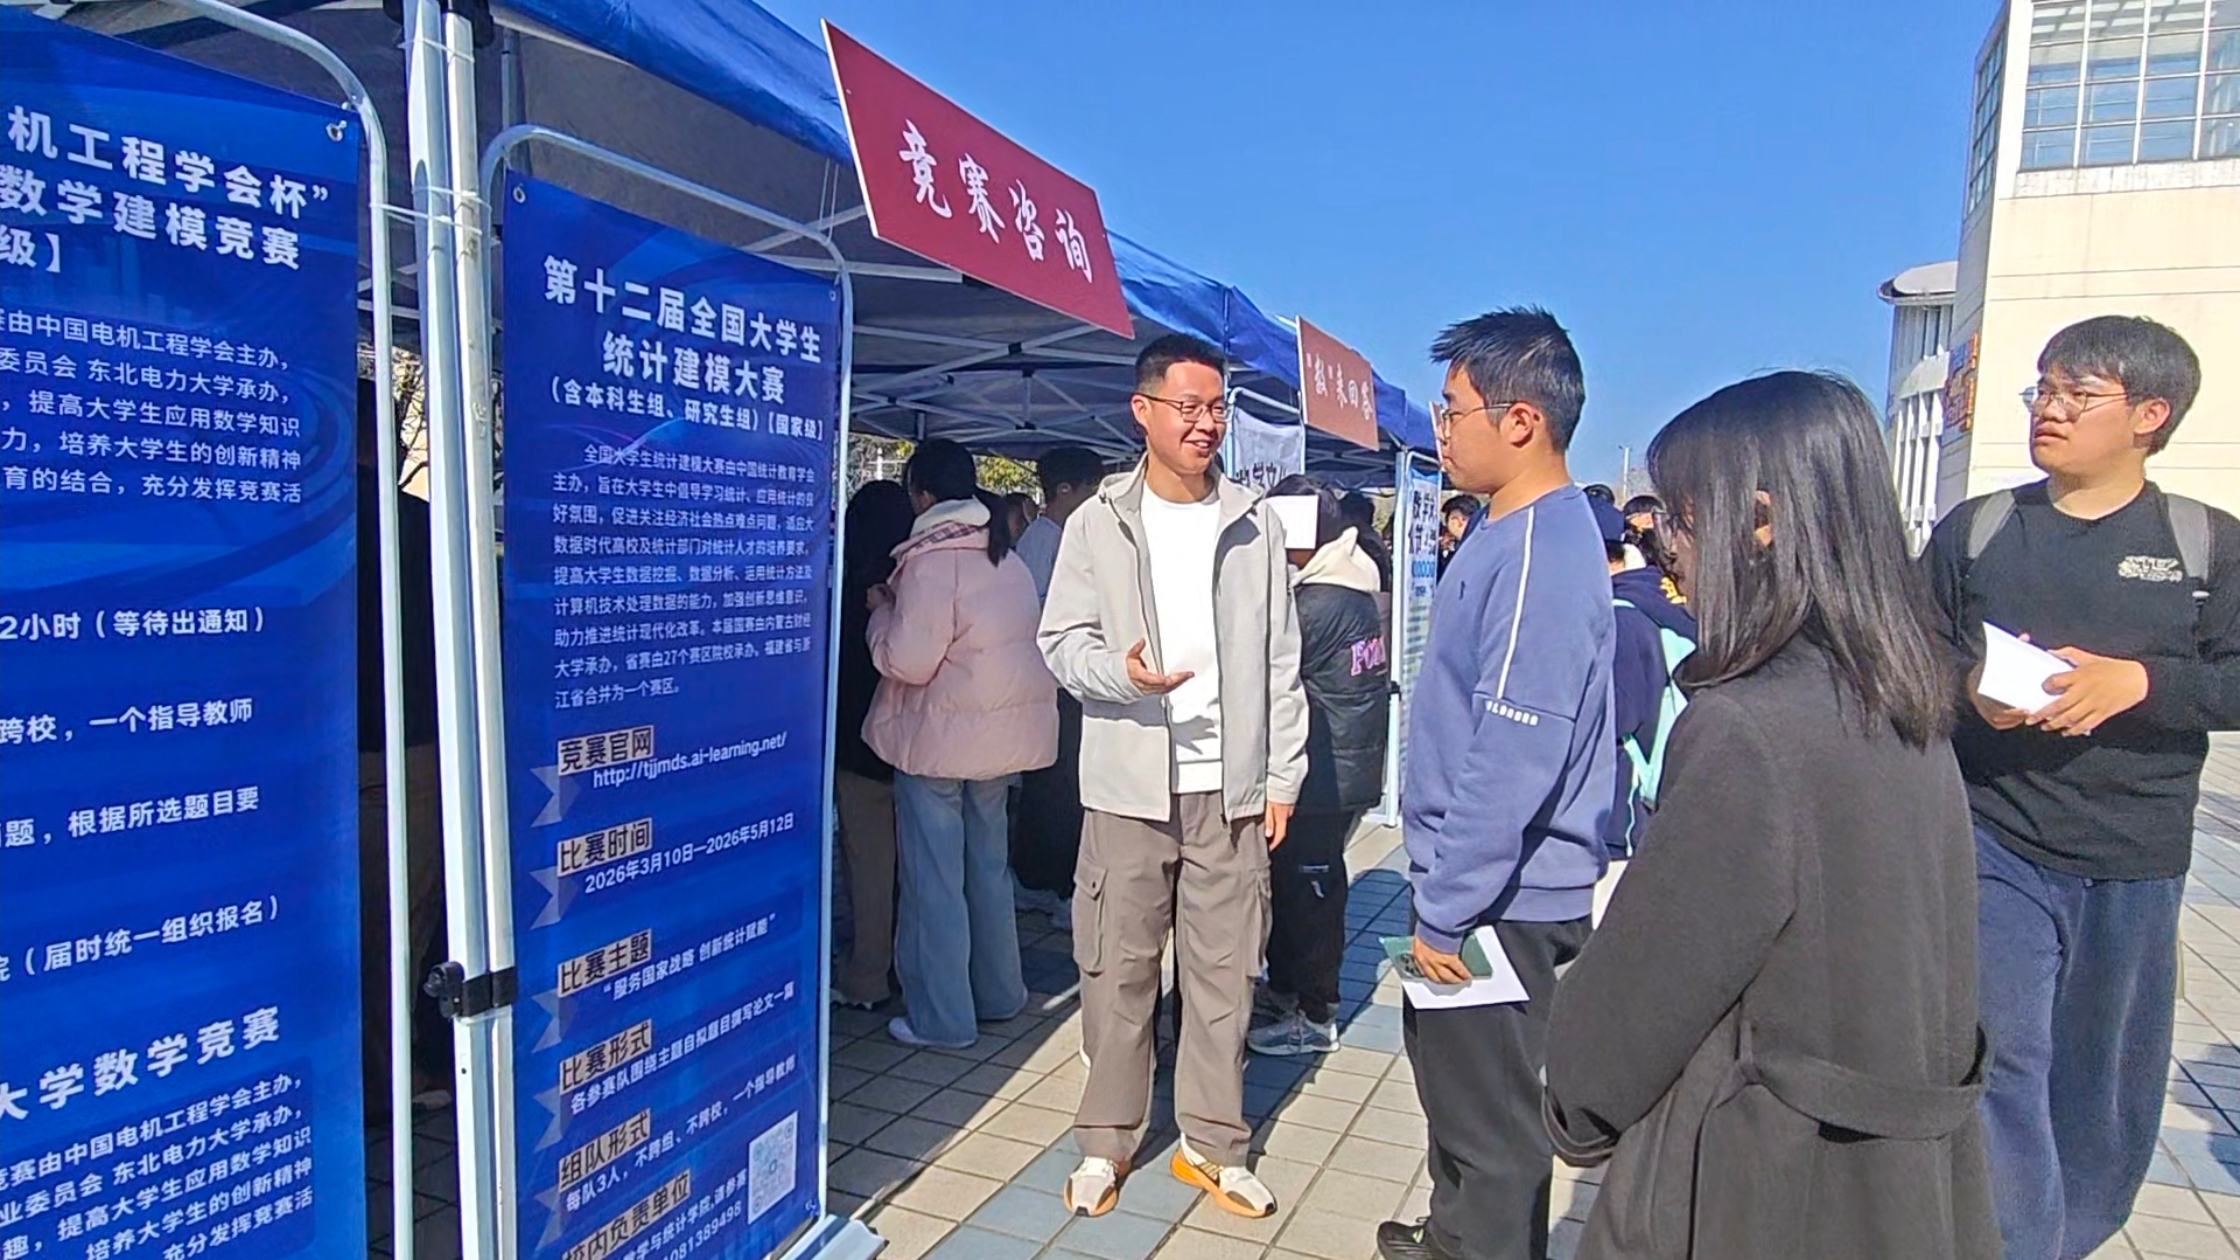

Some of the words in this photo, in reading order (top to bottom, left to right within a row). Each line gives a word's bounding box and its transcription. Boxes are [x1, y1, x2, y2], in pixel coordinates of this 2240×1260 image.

[8, 104, 328, 219] 机工程学会杯”
[0, 164, 301, 270] 数学建模竞赛
[899, 117, 1093, 284] 竞赛咨询
[0, 308, 289, 371] 由中国电机工程学会主办，
[543, 254, 822, 364] 第十二届全国大学生
[0, 348, 77, 379] 委员会
[88, 358, 290, 404] 东北电力大学承办，
[602, 330, 785, 405] 统计建模大赛
[0, 698, 253, 745] 跨校，一个指导教师
[560, 727, 652, 774] 竞赛官网
[560, 820, 651, 874] 比赛时间
[561, 932, 650, 995] 比赛主题
[0, 1006, 280, 1121] 大学数学竞赛
[561, 1022, 650, 1092] 比赛形式
[0, 1173, 104, 1228] 业委员会
[112, 1105, 302, 1186] 东北电力大学承办，
[560, 1112, 648, 1188] 组队形式
